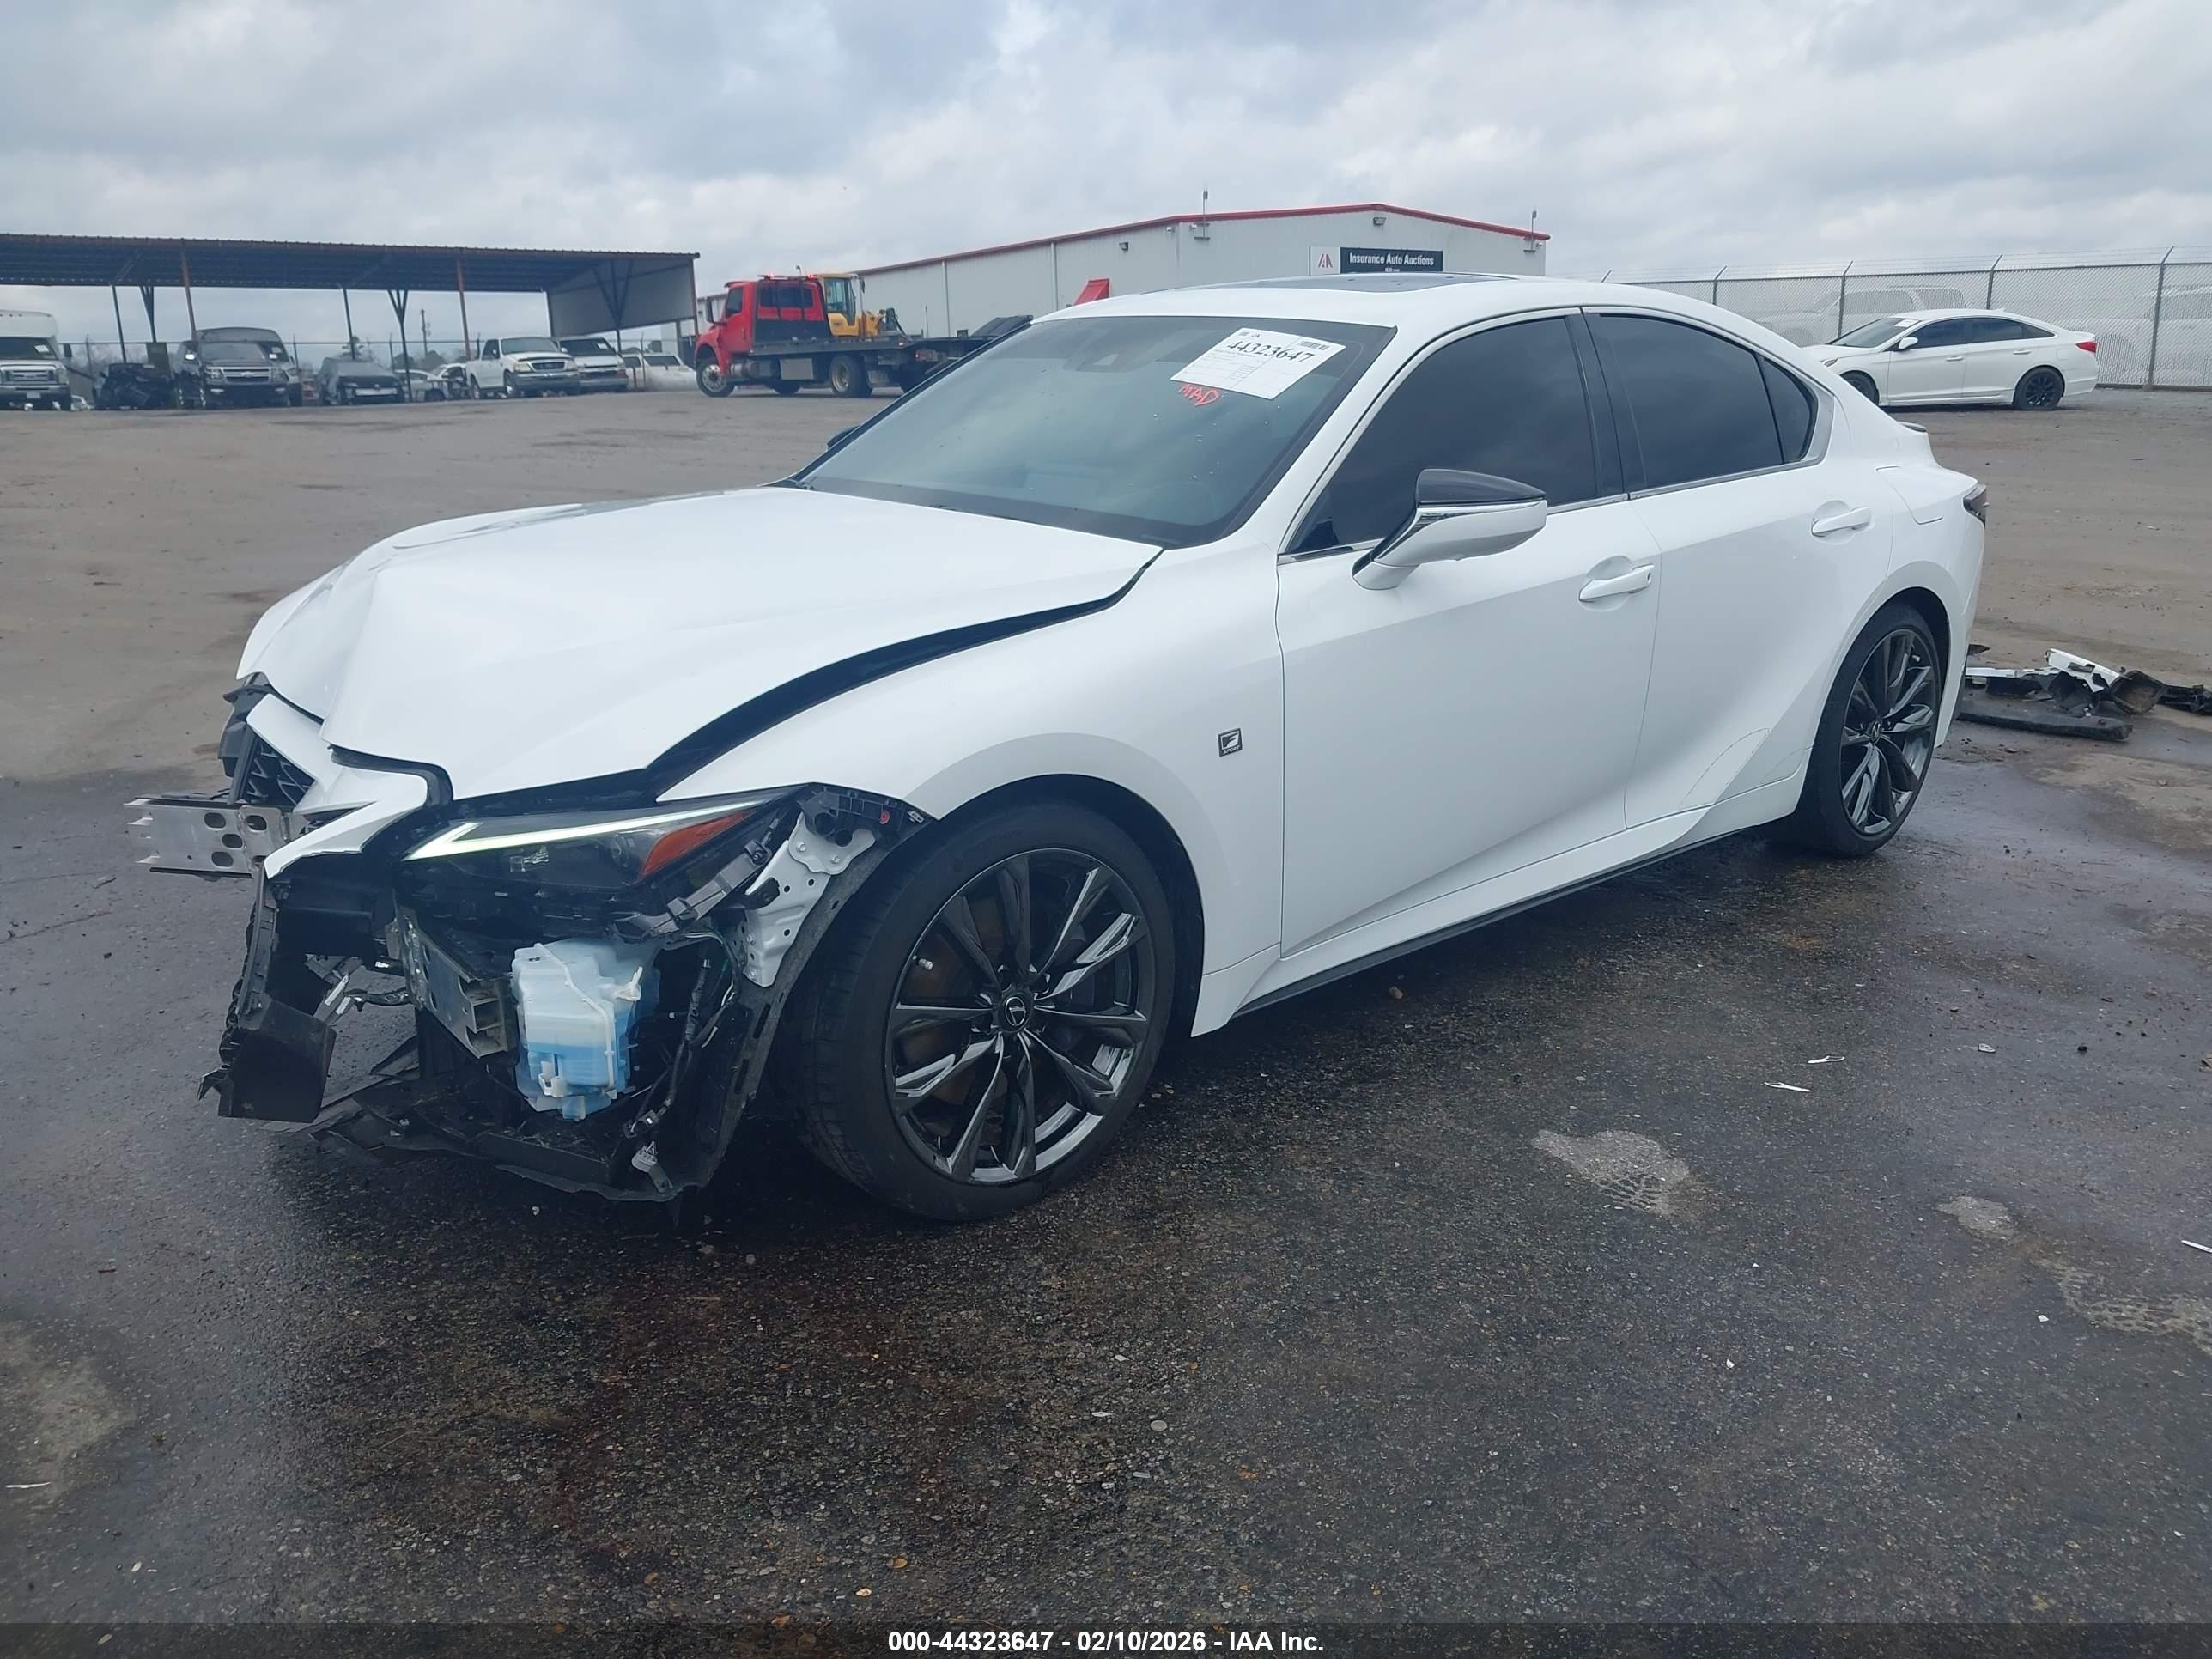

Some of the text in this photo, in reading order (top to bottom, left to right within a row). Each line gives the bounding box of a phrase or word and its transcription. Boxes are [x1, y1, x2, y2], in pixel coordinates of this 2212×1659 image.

[1349, 252, 1434, 266] Insurance Auto Auctions
[1227, 341, 1315, 363] 44323647
